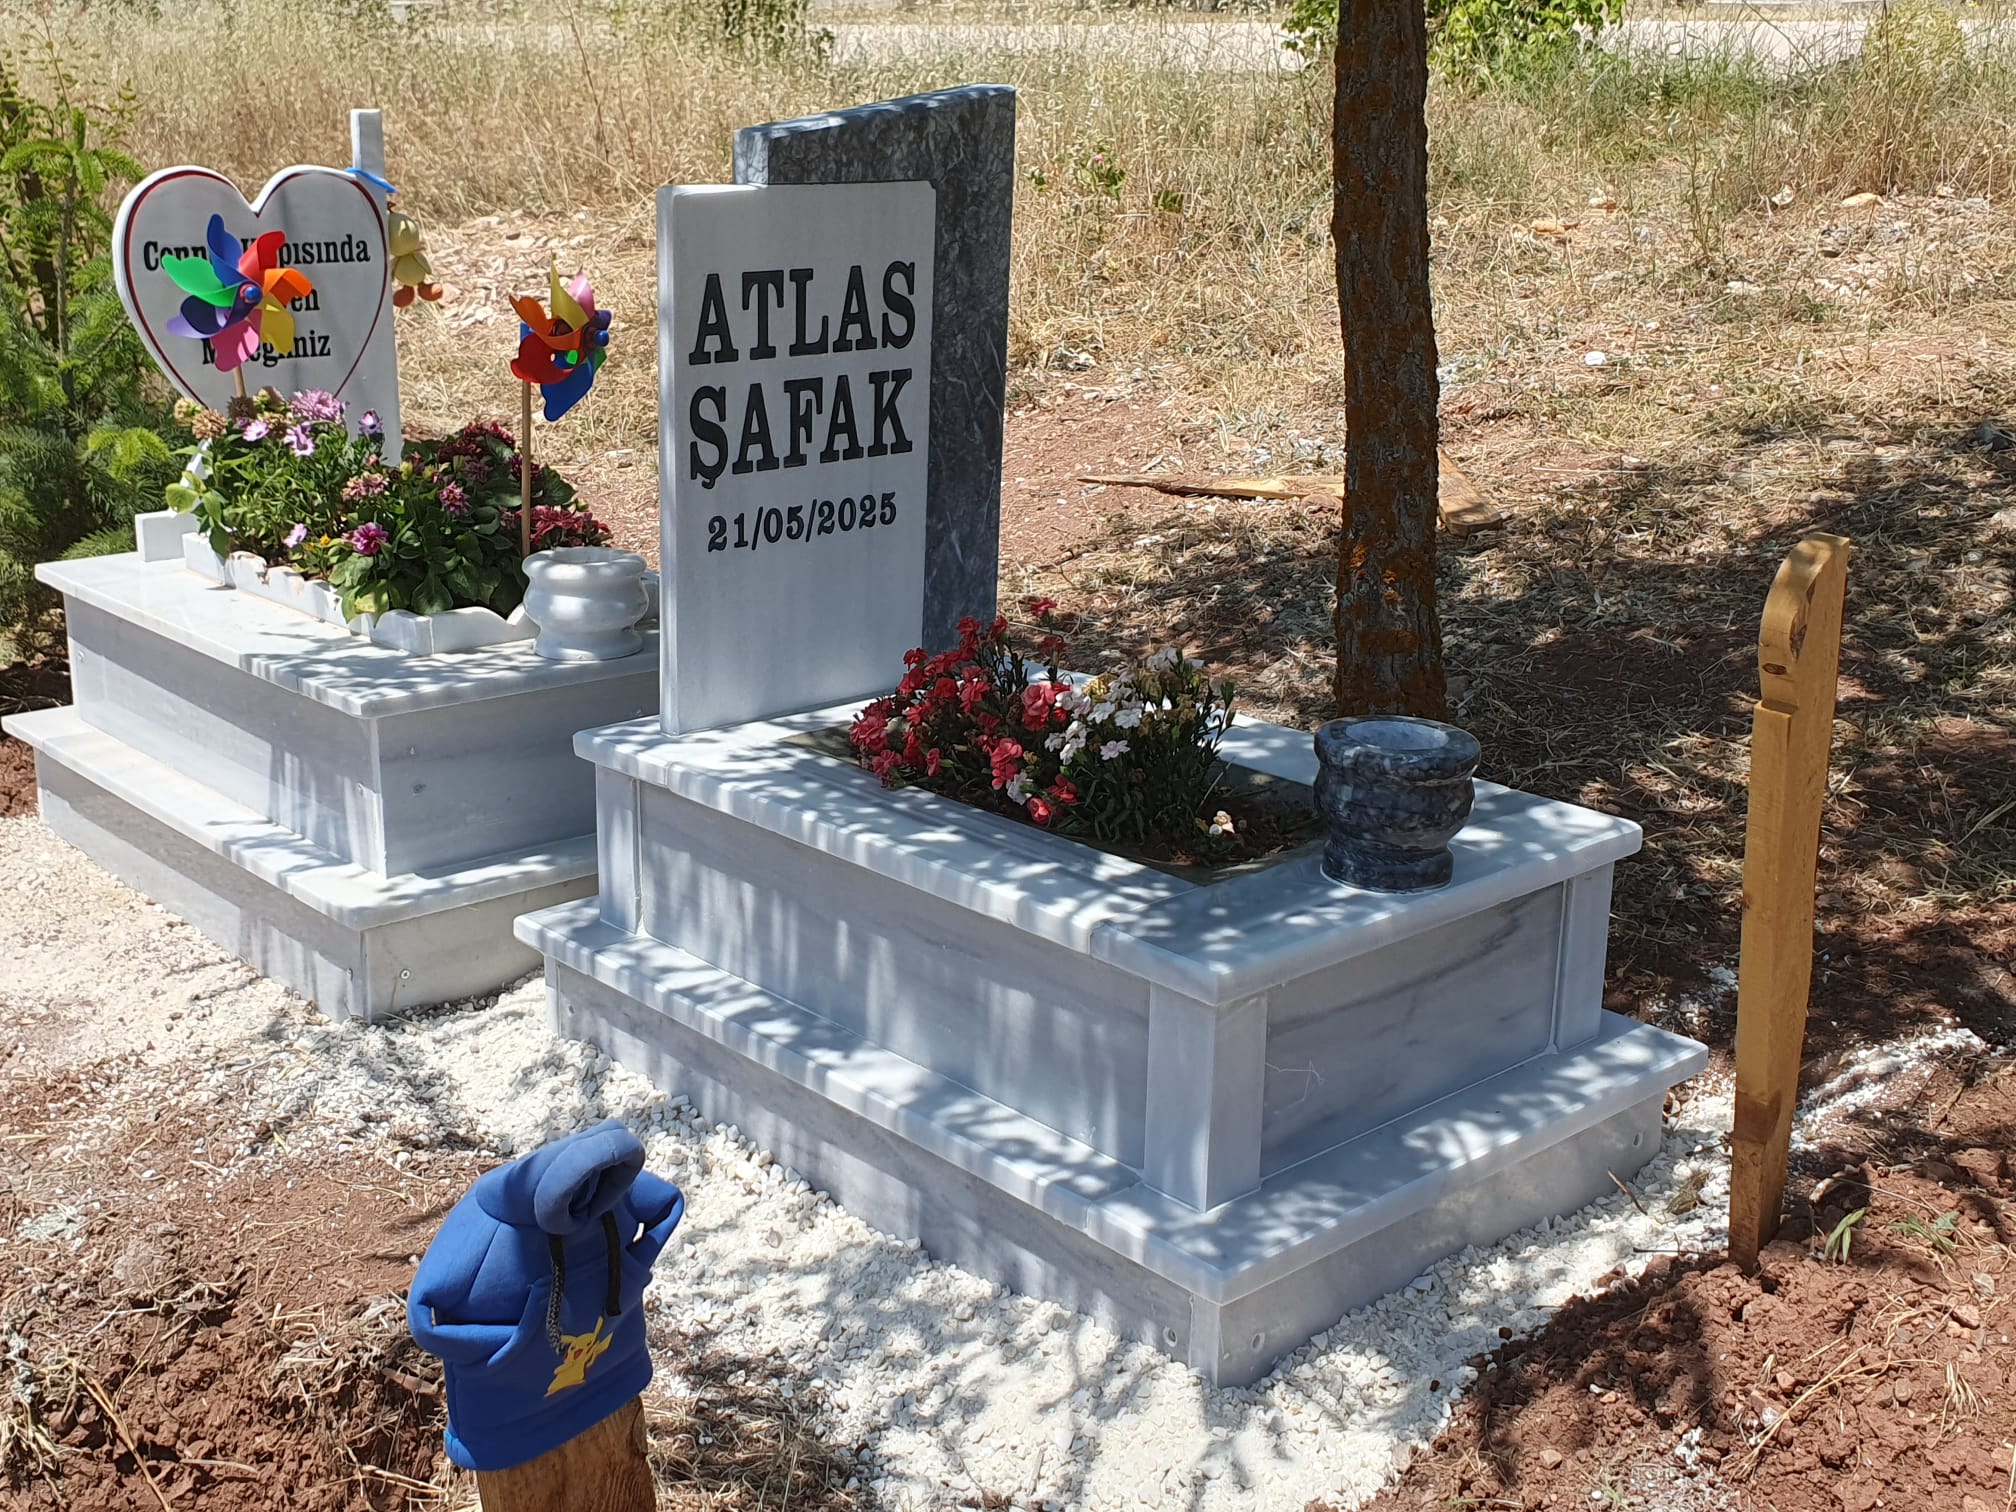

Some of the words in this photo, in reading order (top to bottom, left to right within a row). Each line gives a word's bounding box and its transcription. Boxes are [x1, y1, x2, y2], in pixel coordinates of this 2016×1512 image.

[688, 260, 916, 366] ATLAS
[689, 368, 913, 489] ŞAFAK
[707, 491, 897, 552] 21/05/2025
